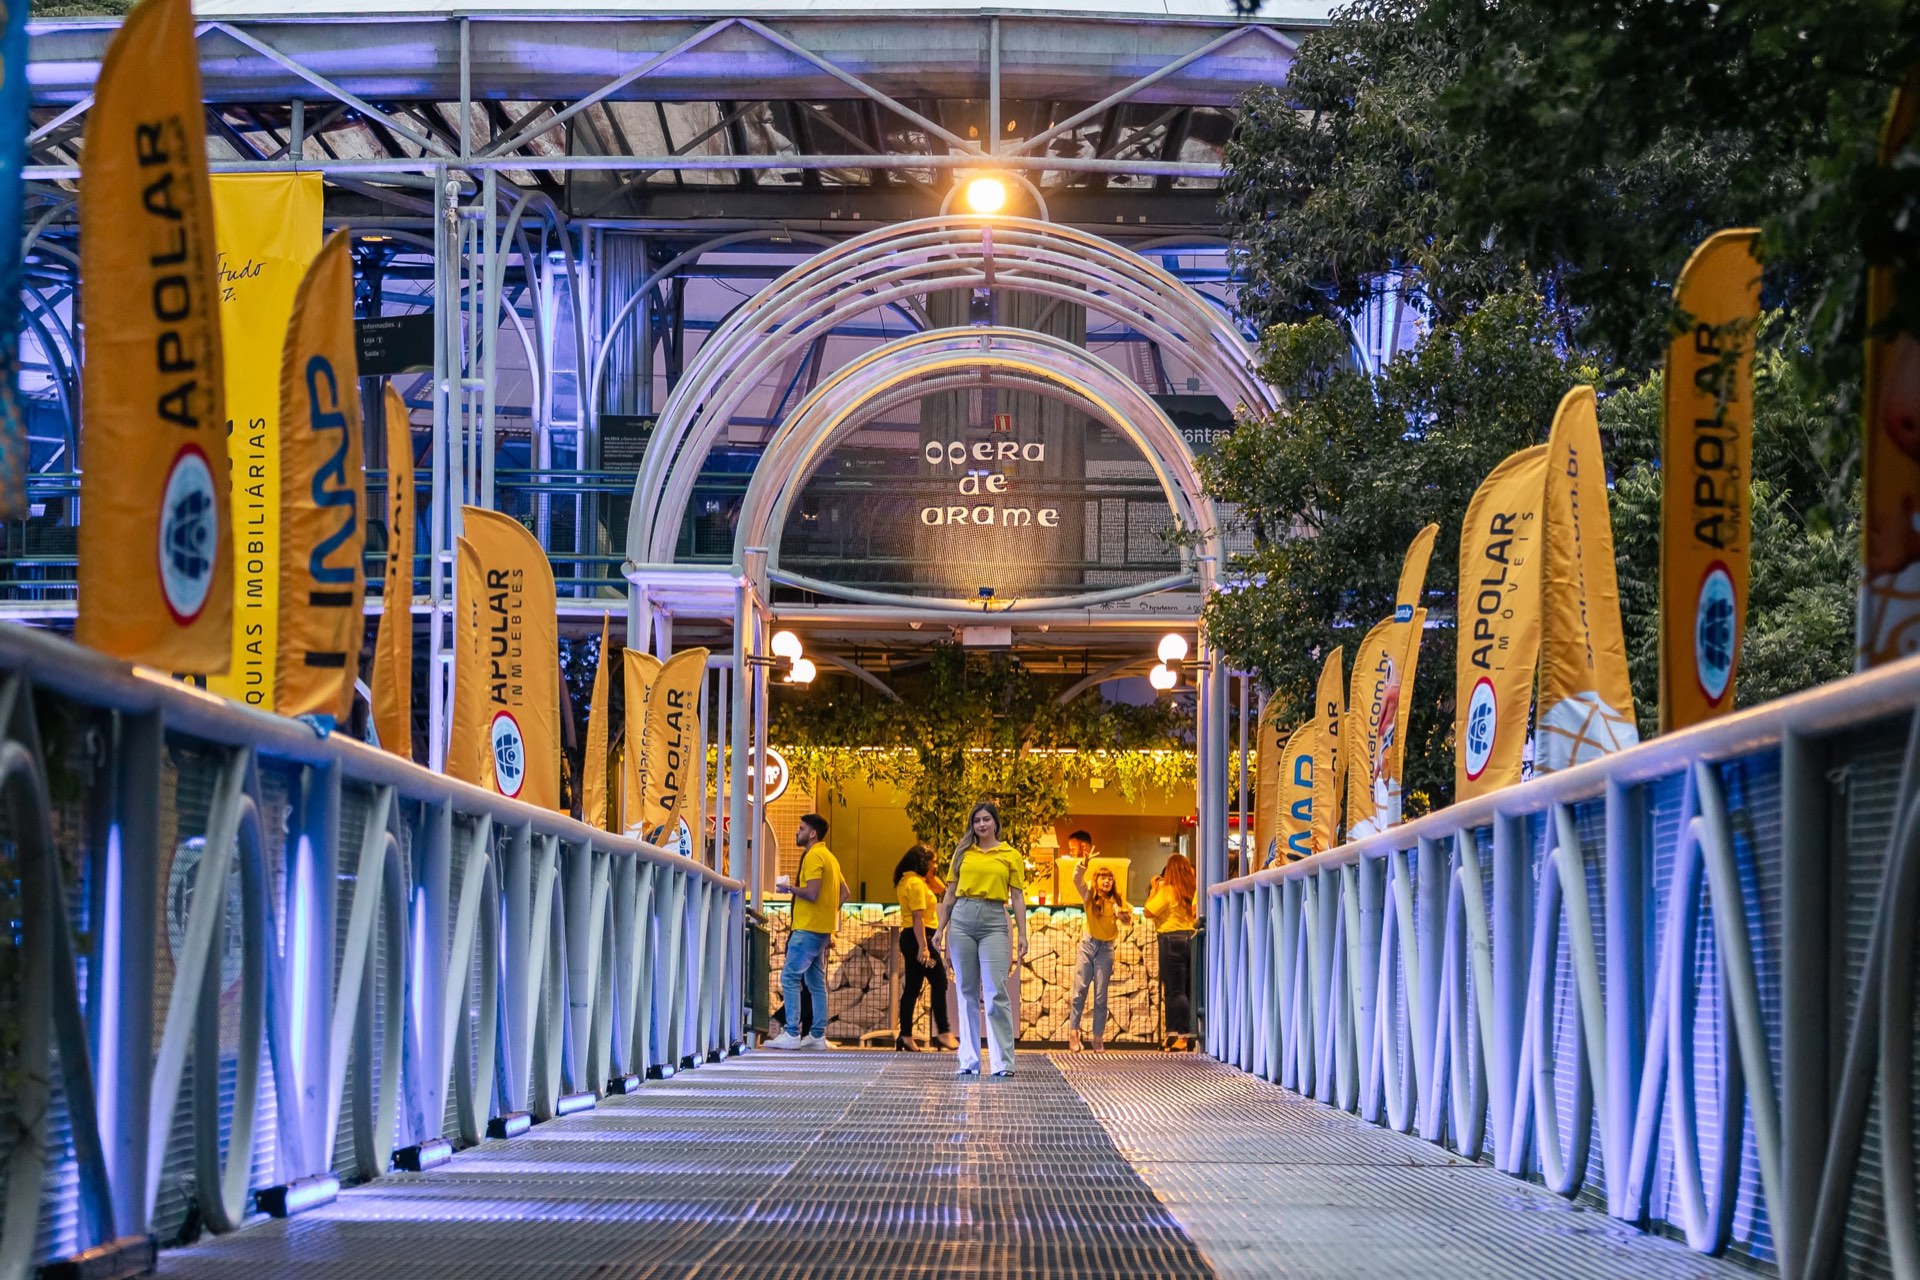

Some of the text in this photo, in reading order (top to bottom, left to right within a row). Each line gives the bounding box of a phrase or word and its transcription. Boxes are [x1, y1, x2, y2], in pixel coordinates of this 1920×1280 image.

[136, 122, 199, 430] APOLAR
[246, 417, 267, 606] IMOBILIÁRIAS
[959, 470, 1009, 495] de
[511, 568, 524, 707] INMUEBLES
[1470, 512, 1516, 671] APOLAR
[1496, 512, 1534, 671] IMÓVEIS
[659, 688, 685, 811] APOLAR
